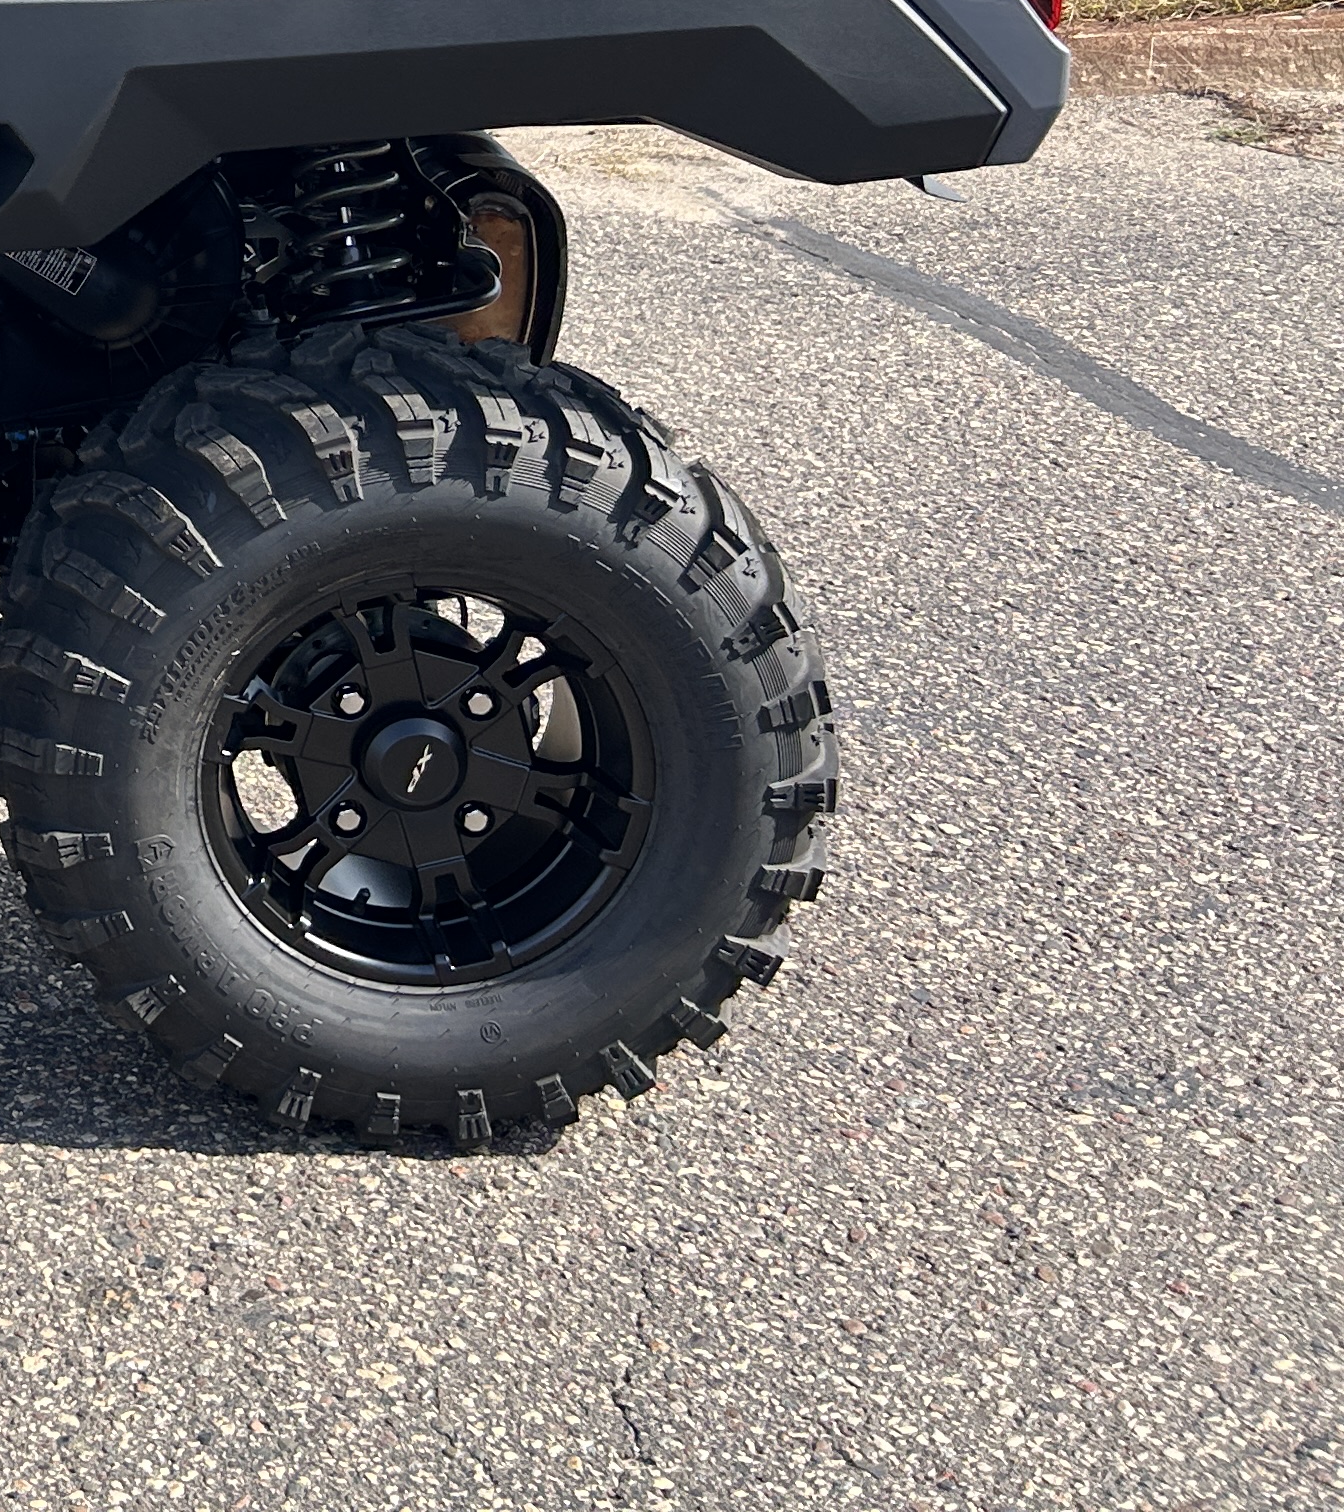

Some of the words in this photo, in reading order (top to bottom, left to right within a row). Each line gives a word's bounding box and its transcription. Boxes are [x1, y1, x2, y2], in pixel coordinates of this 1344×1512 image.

[407, 743, 433, 793] XP
[149, 870, 253, 997] ARMOR
[244, 988, 324, 1048] PRO
